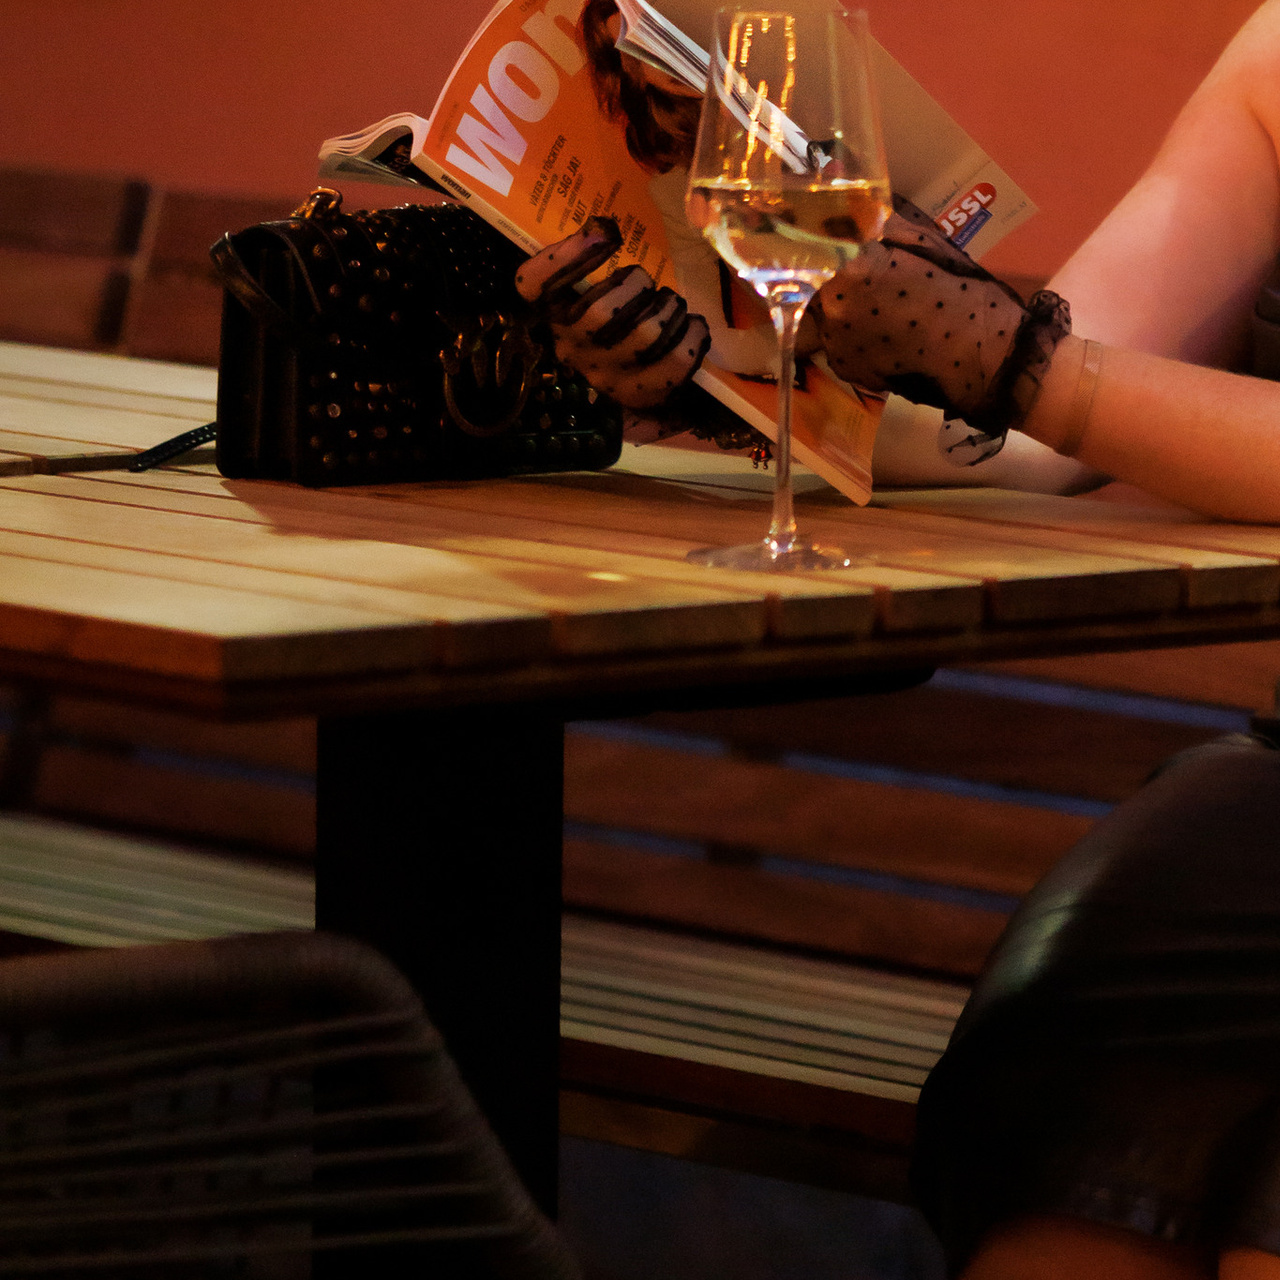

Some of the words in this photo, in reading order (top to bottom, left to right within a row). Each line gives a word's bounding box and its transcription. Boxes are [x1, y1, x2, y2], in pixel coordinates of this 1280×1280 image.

[441, 174, 471, 199] woman
[529, 180, 545, 207] VATER
[540, 173, 548, 182] &
[557, 174, 572, 198] SAG
[566, 155, 581, 177] JA!
[572, 199, 587, 226] MUT
[627, 221, 646, 257] SONNE
